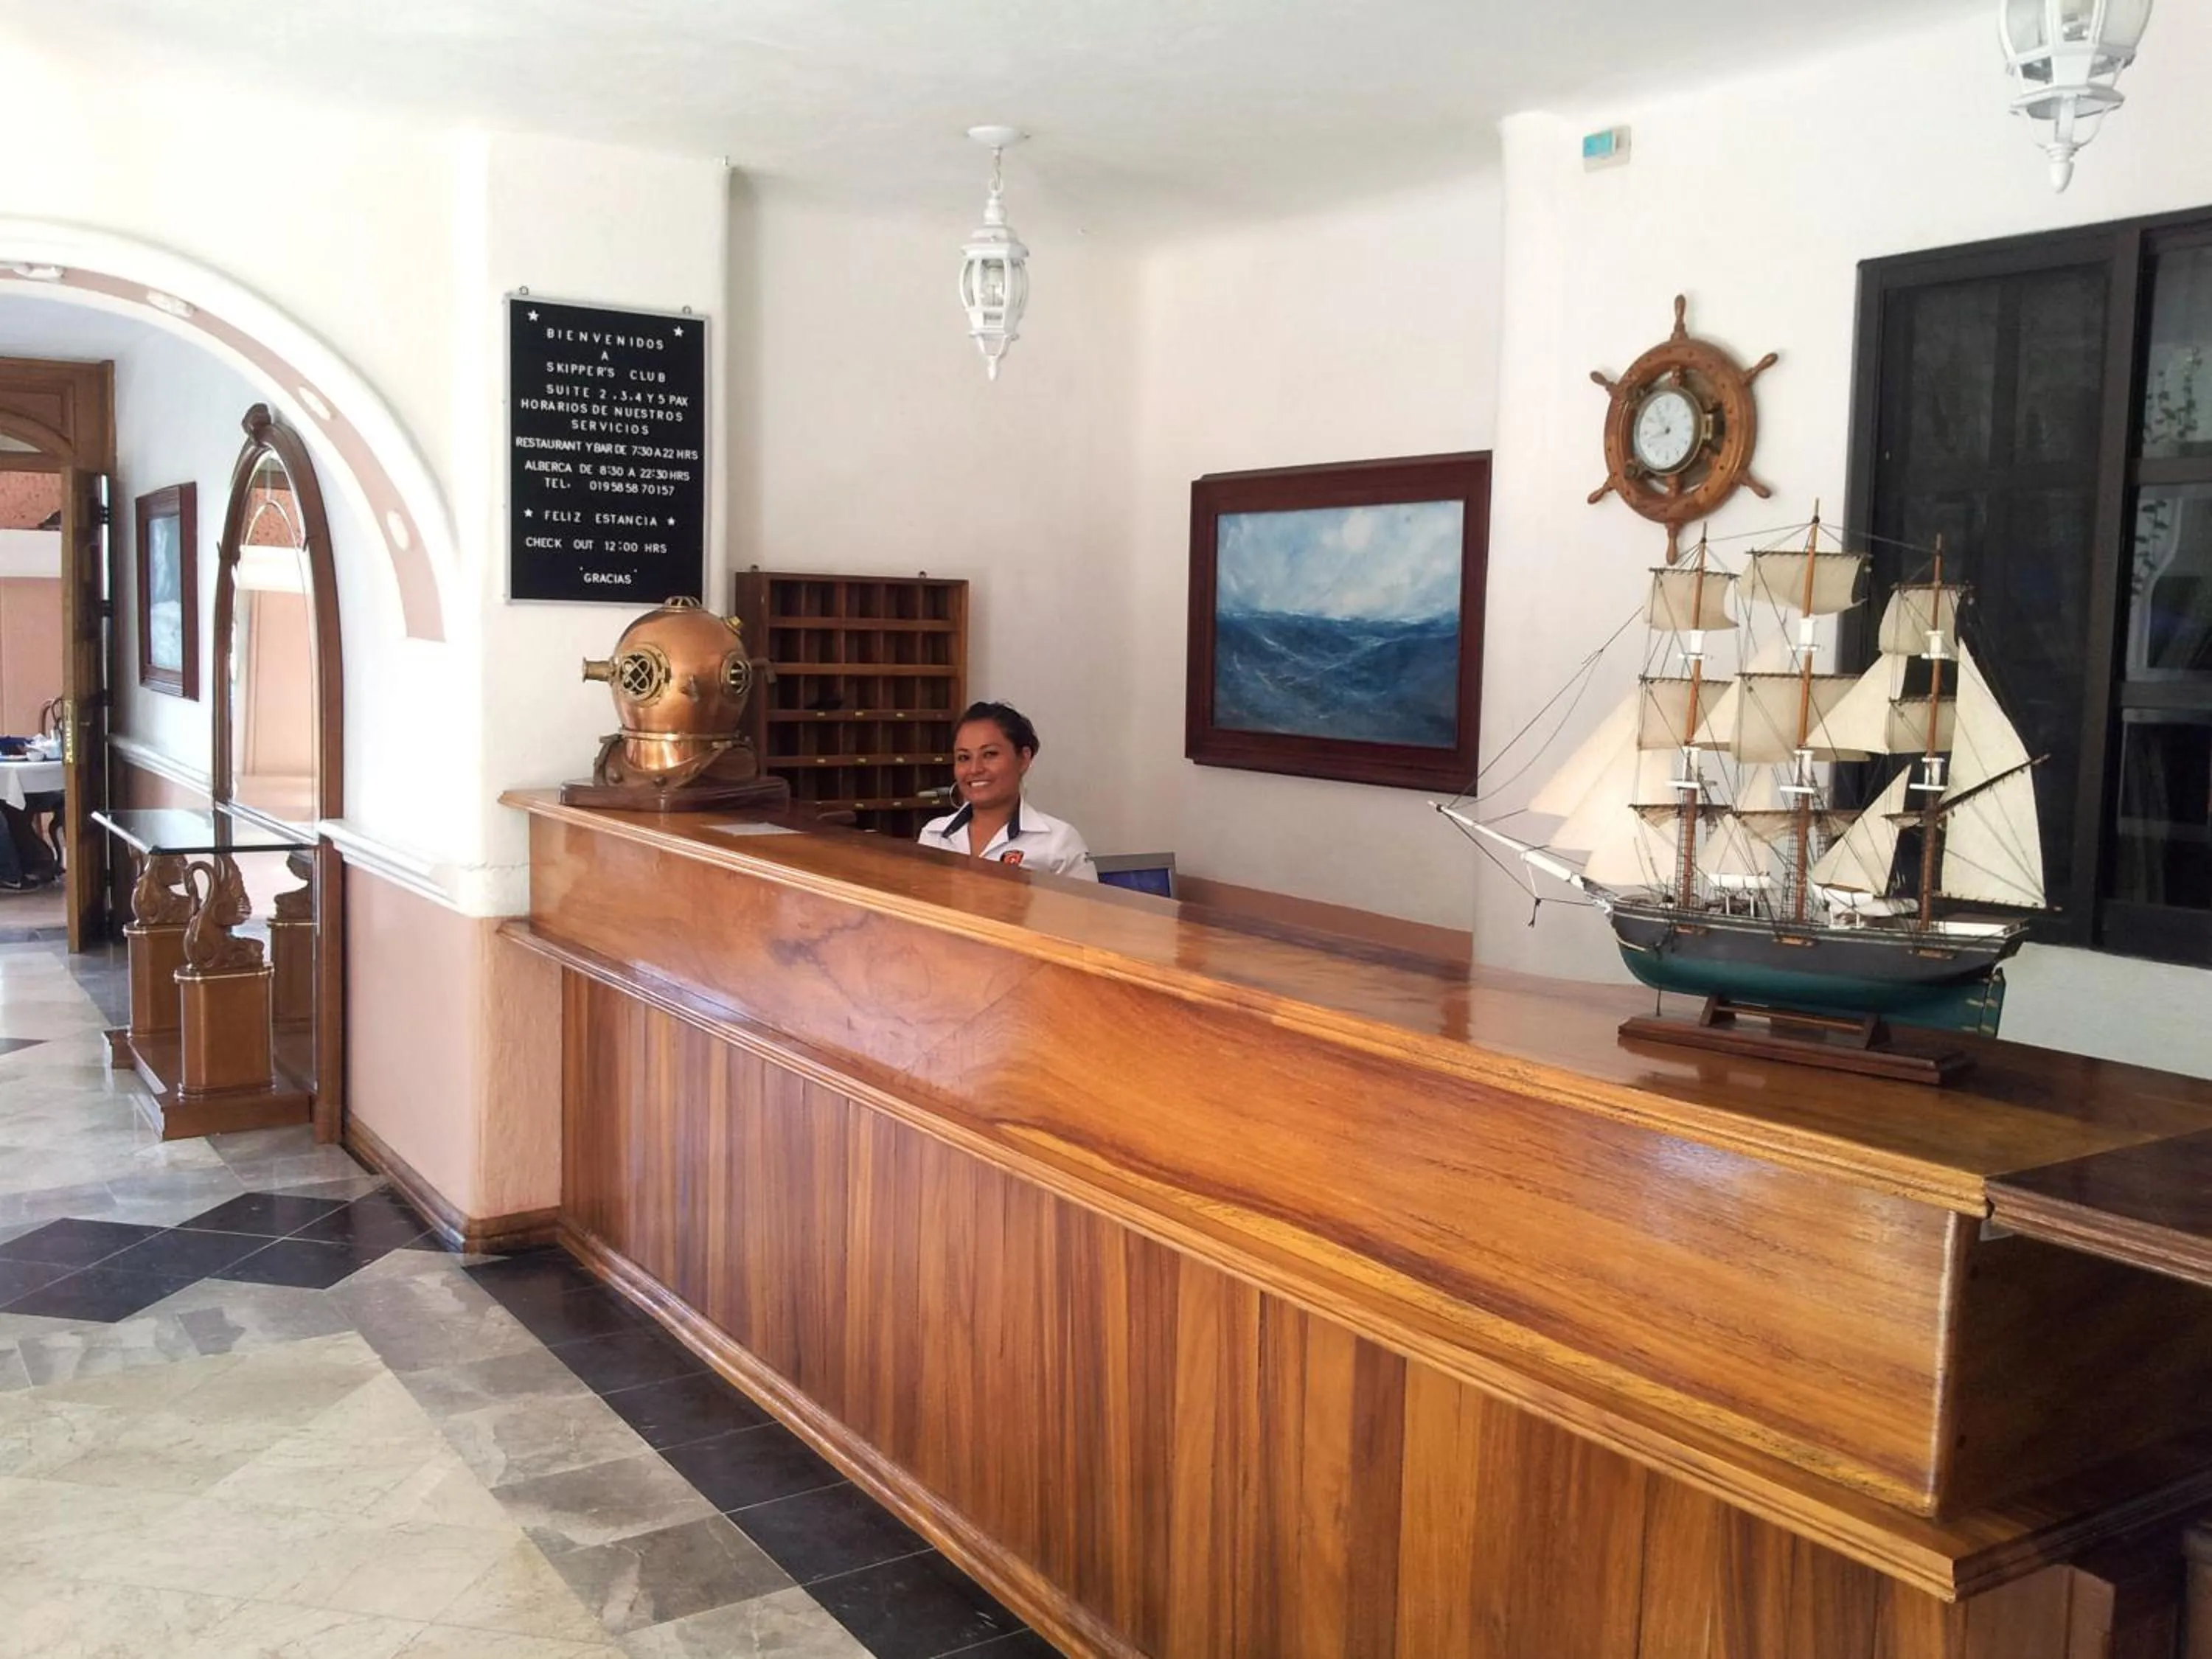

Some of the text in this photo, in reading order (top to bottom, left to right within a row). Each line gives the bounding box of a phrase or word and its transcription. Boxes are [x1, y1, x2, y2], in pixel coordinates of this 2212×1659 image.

[546, 327, 664, 350] BIENVENIDOS
[601, 350, 609, 361] A
[546, 361, 666, 383] SKIPPER'S CLUB
[546, 383, 590, 398] SUITE
[647, 393, 654, 403] Y
[658, 394, 666, 405] 5
[669, 394, 688, 407] PAX
[521, 398, 683, 422] HORARIOS DE NUESTROS
[571, 419, 650, 436] SERVICIOS
[515, 436, 582, 451] RESTAURANT
[662, 448, 675, 459] 22
[676, 449, 698, 461] HRS
[524, 459, 690, 481] ALBERCA DE 8:30 A 22:30 HRS
[544, 477, 571, 489] TEL.
[544, 509, 657, 526] FELIZ ESTANCIA
[525, 536, 667, 554] CHECK OUT 12:00 HRS
[583, 572, 632, 585] GRACIAS
